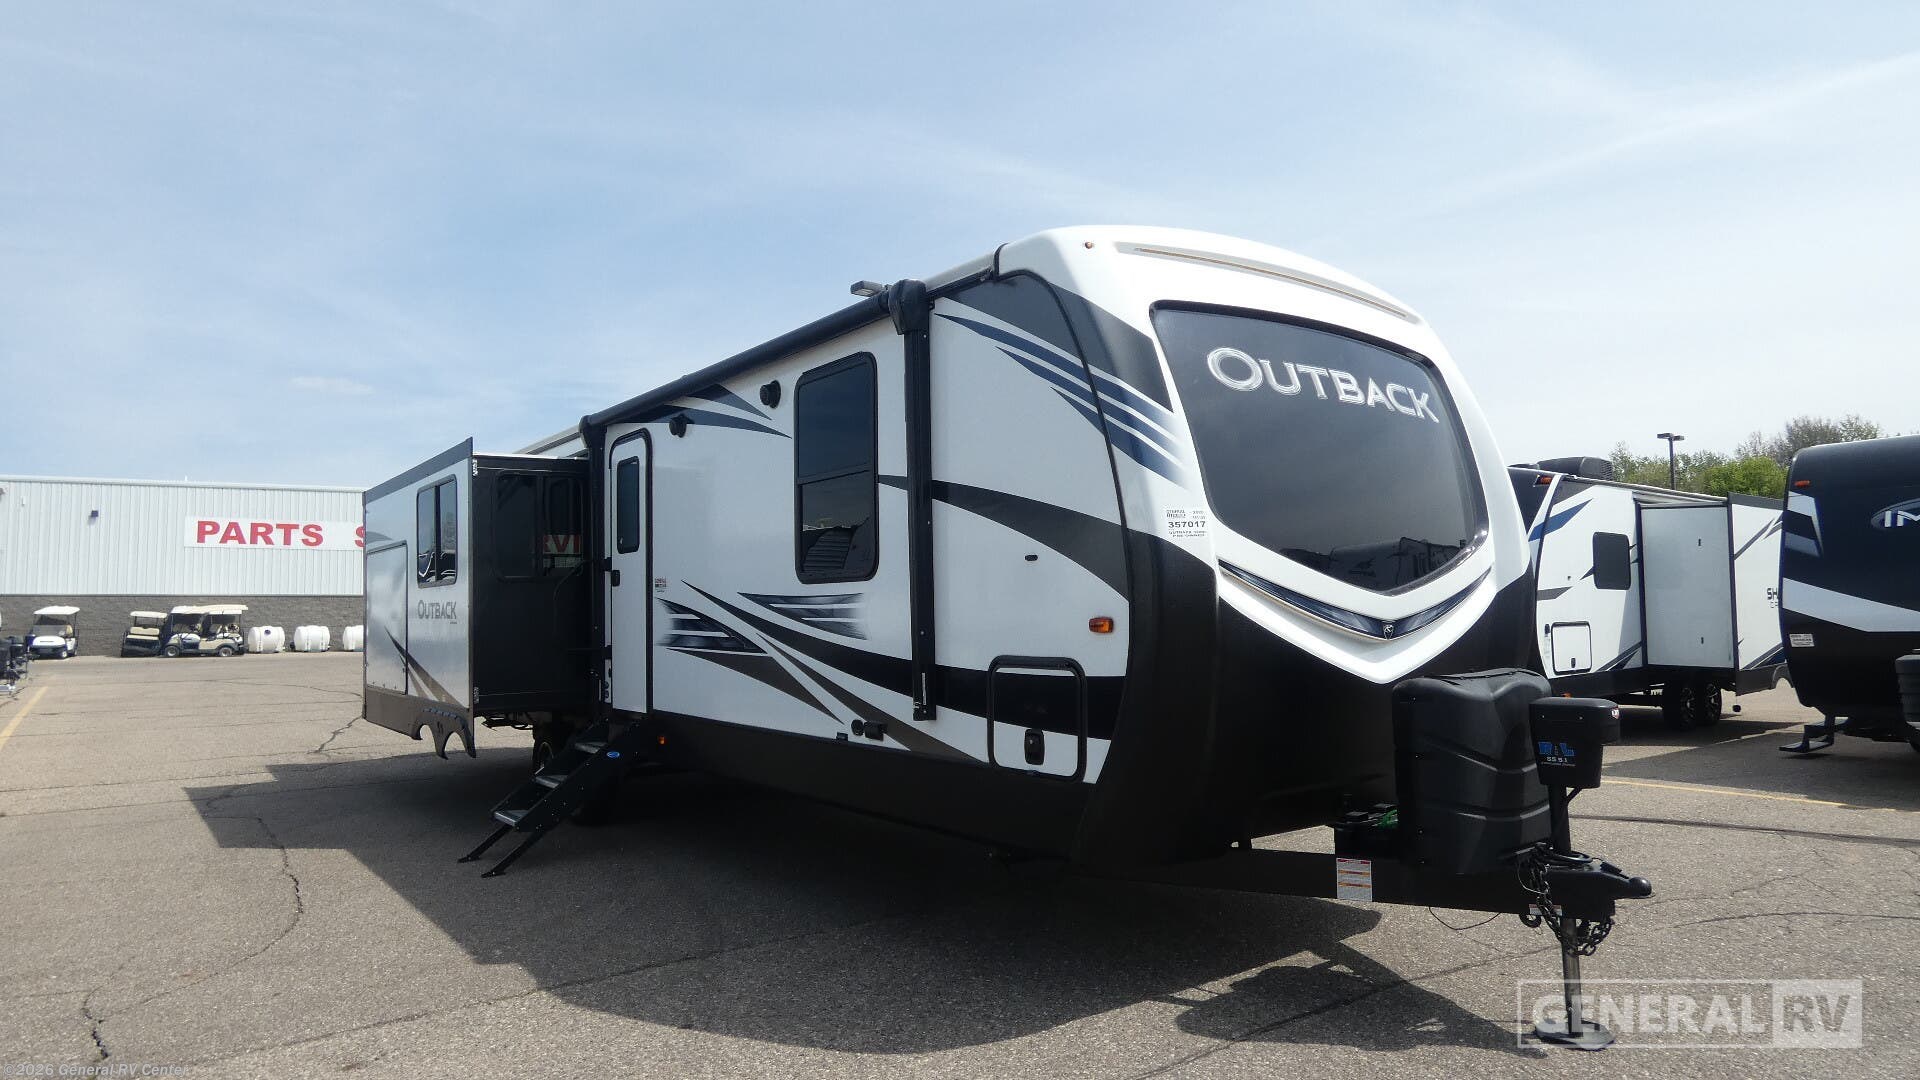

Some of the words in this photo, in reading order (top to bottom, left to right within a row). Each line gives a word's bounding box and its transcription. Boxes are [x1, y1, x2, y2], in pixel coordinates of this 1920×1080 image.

[1206, 347, 1439, 424] OUTBACK
[196, 520, 324, 547] PARTS
[1168, 520, 1206, 528] 357017
[417, 599, 457, 620] OUTBACK
